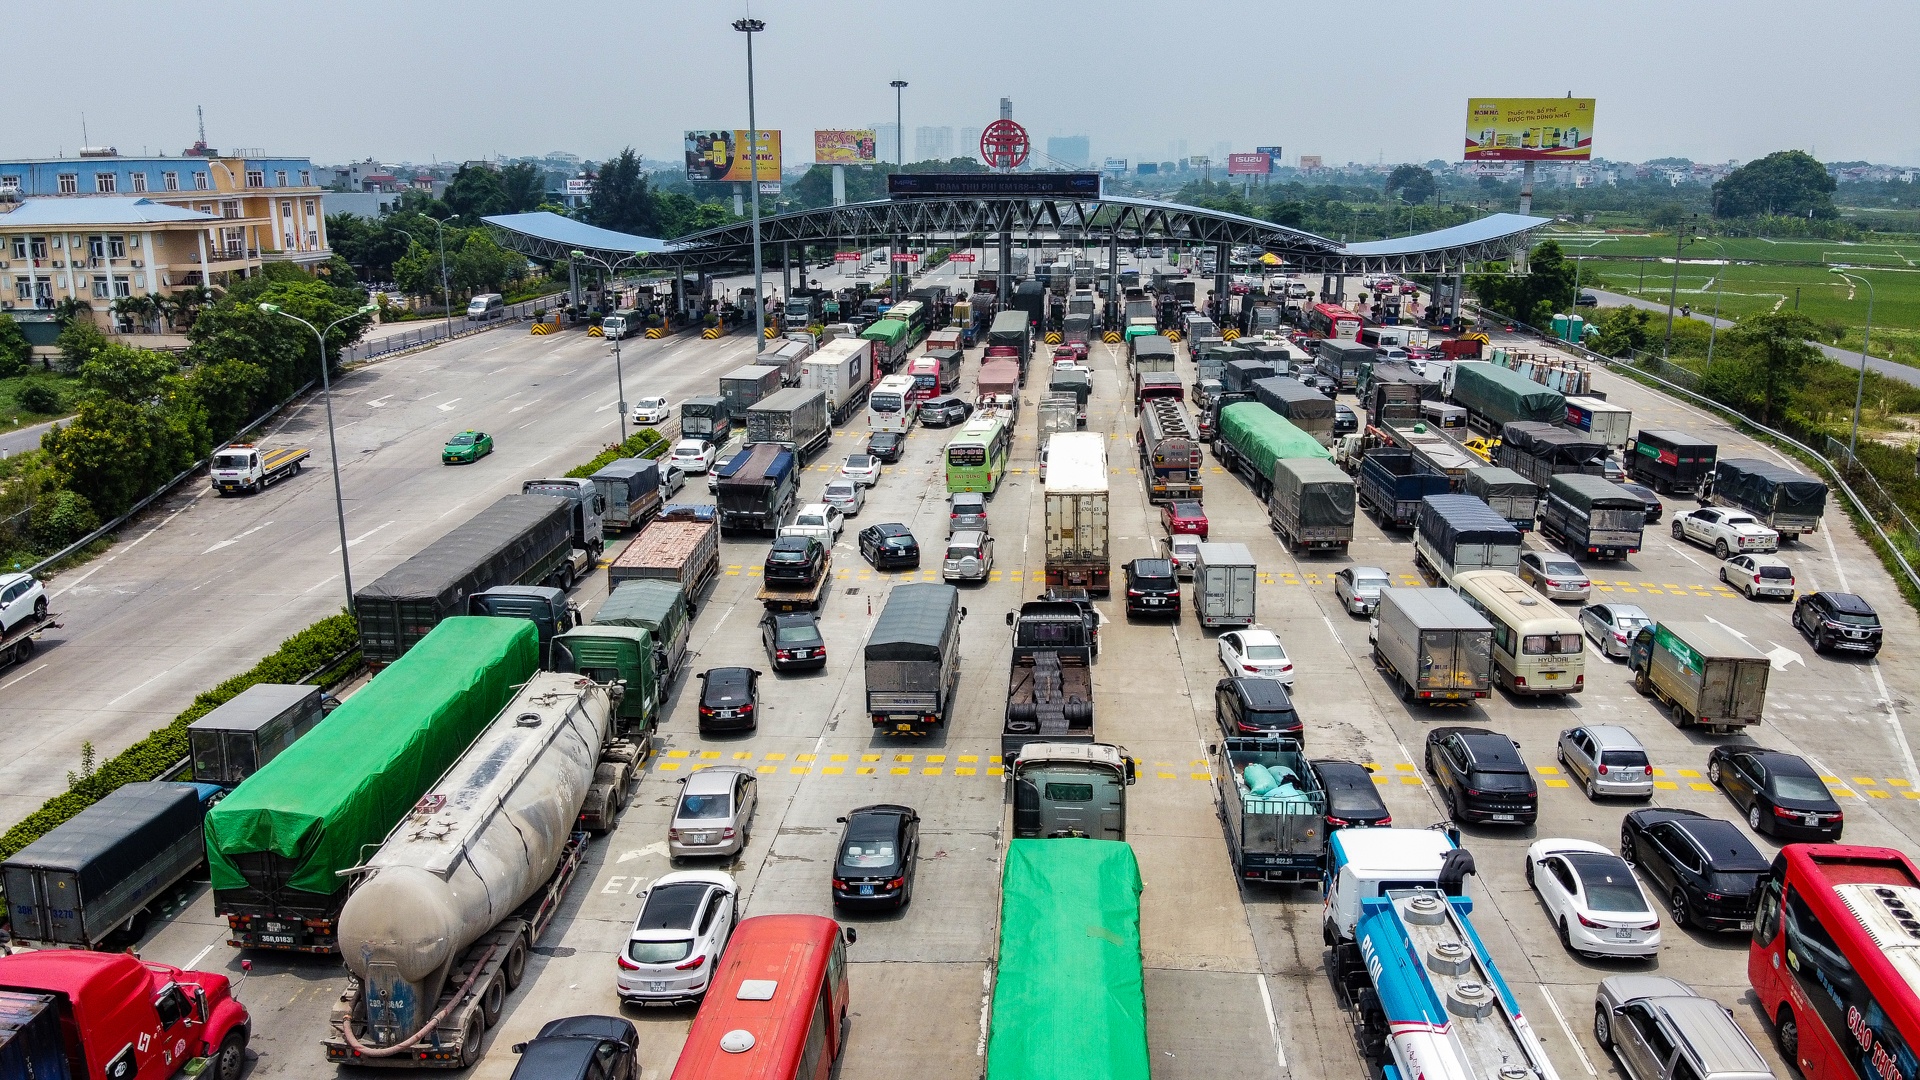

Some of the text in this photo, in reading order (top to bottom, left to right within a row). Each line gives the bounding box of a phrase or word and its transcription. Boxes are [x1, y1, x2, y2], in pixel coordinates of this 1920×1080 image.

[1554, 111, 1571, 119] NHẤT
[18, 905, 74, 919] 30H 3270
[1362, 934, 1383, 990] PV OIL
[1848, 1006, 1872, 1052] GIAO
